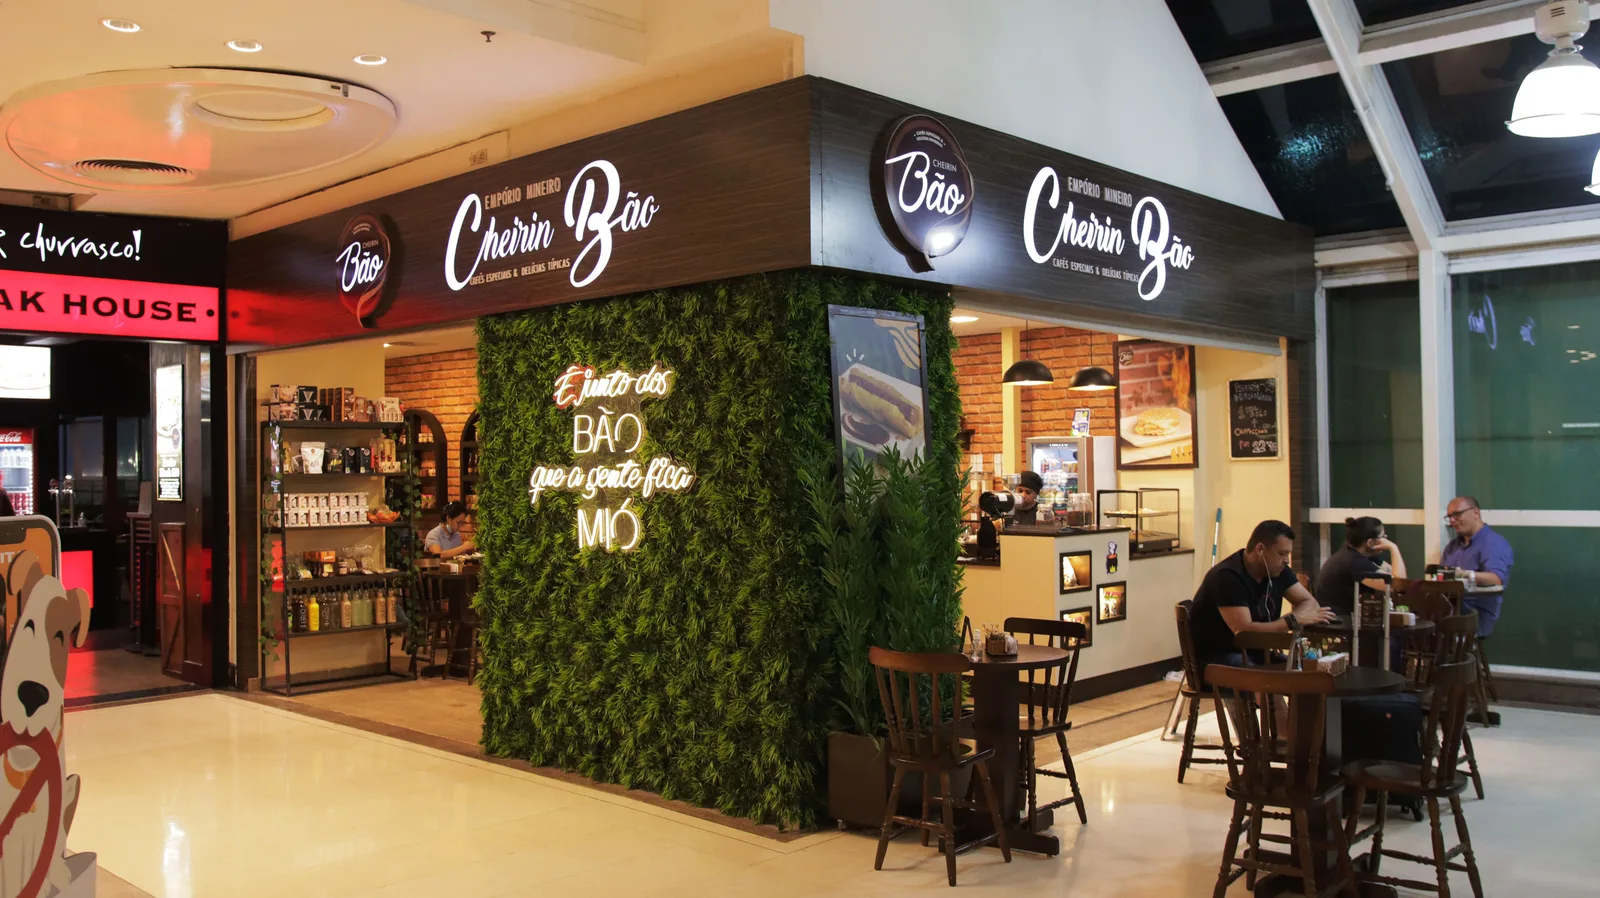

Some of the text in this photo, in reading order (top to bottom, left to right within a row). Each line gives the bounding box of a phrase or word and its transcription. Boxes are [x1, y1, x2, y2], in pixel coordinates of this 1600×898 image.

[885, 151, 965, 215] Bão
[932, 158, 957, 172] CHEIRIN
[484, 177, 562, 210] EMPÓRIO MINEIRO
[1067, 176, 1133, 207] EMPÓRIO MINEIRO
[20, 222, 142, 262] churrasco!
[444, 159, 660, 292] Cheirin Bão
[1023, 166, 1195, 301] Cheirin Bão
[336, 241, 383, 292] Bão
[469, 258, 571, 286] CAFÉS ESPECIAIS & DELÍCIAS TÍPICAS
[1052, 257, 1140, 283] CAFÉS ESPECIAIS & DELÍCIAS TÍPICAS
[63, 293, 197, 323] HOUSE
[574, 369, 636, 406] junto
[634, 364, 673, 395] dos
[573, 406, 642, 454] BÃO
[529, 457, 694, 504] que a gente fica
[577, 497, 641, 550] MIÓ
